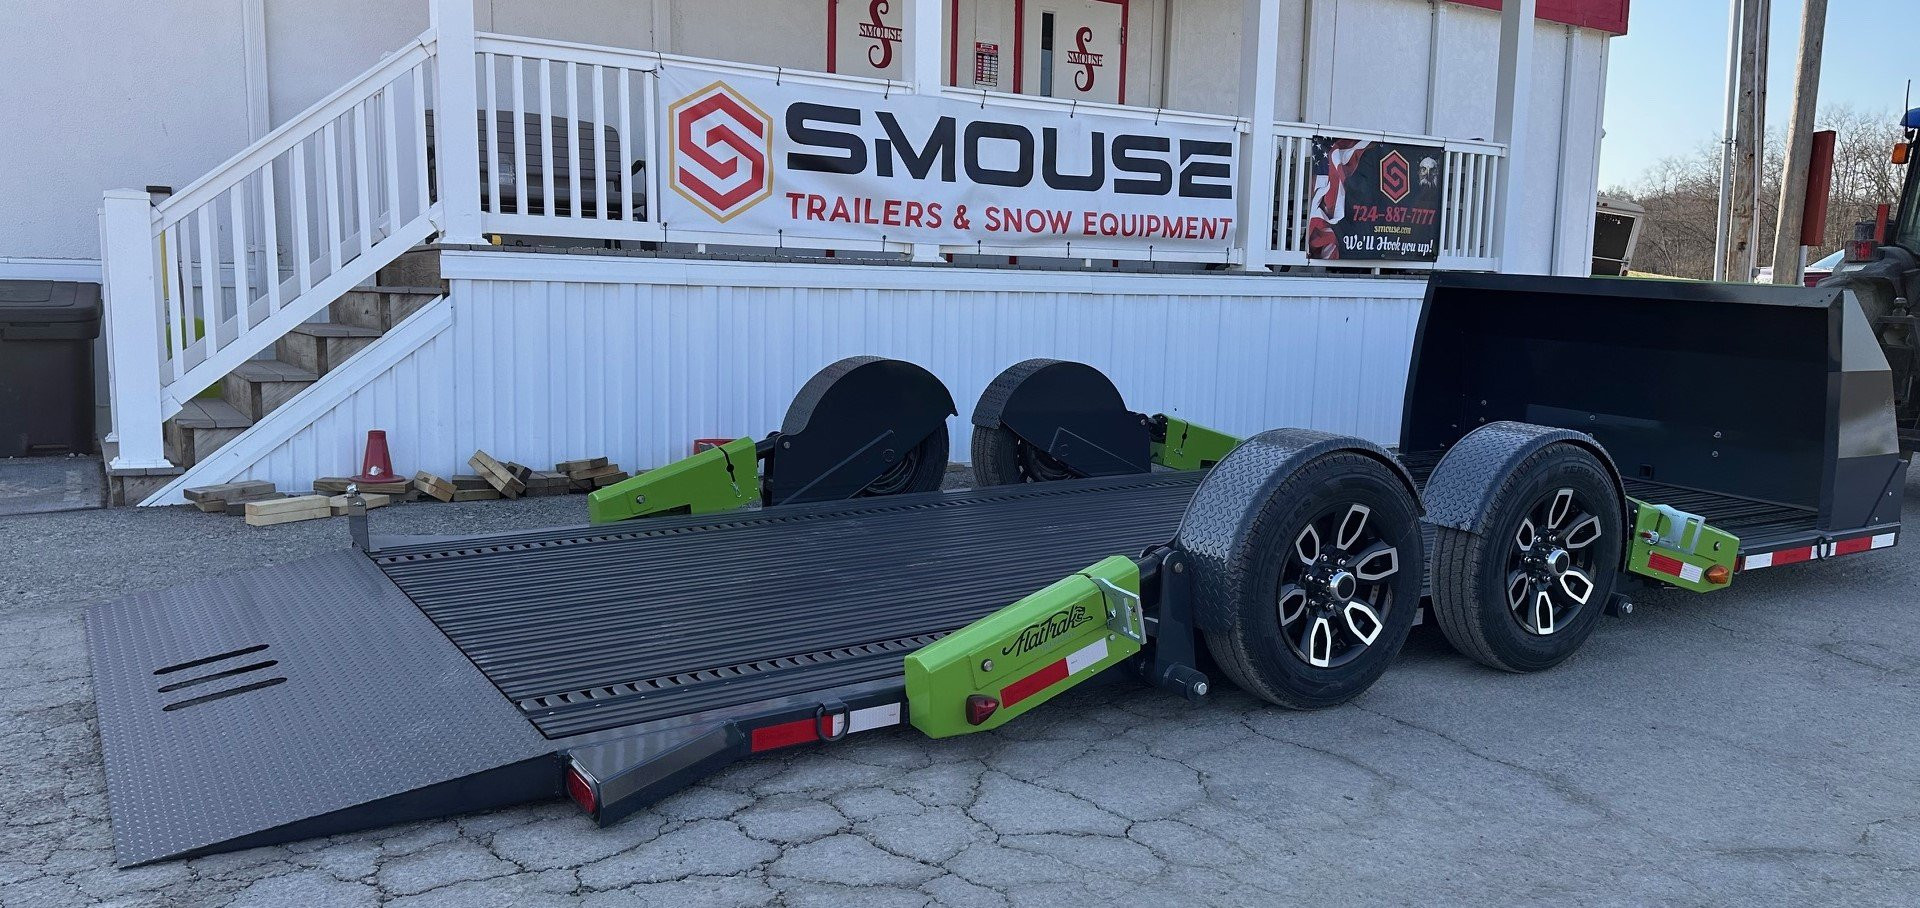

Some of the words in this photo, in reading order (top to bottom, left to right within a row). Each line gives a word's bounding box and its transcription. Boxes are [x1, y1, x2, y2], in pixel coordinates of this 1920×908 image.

[860, 25, 902, 41] SMOUSE
[1067, 52, 1103, 66] SMOUSE
[785, 101, 1233, 200] SMOUSE
[786, 192, 942, 229] TRAILERS
[953, 204, 970, 230] &
[985, 206, 1073, 234] SNOW
[1083, 212, 1232, 240] EQUIPMENT
[1353, 205, 1436, 224] 724-887-7777
[1343, 235, 1374, 251] We'll
[1377, 236, 1401, 251] Hook
[1401, 241, 1416, 255] you
[1418, 239, 1434, 256] up!
